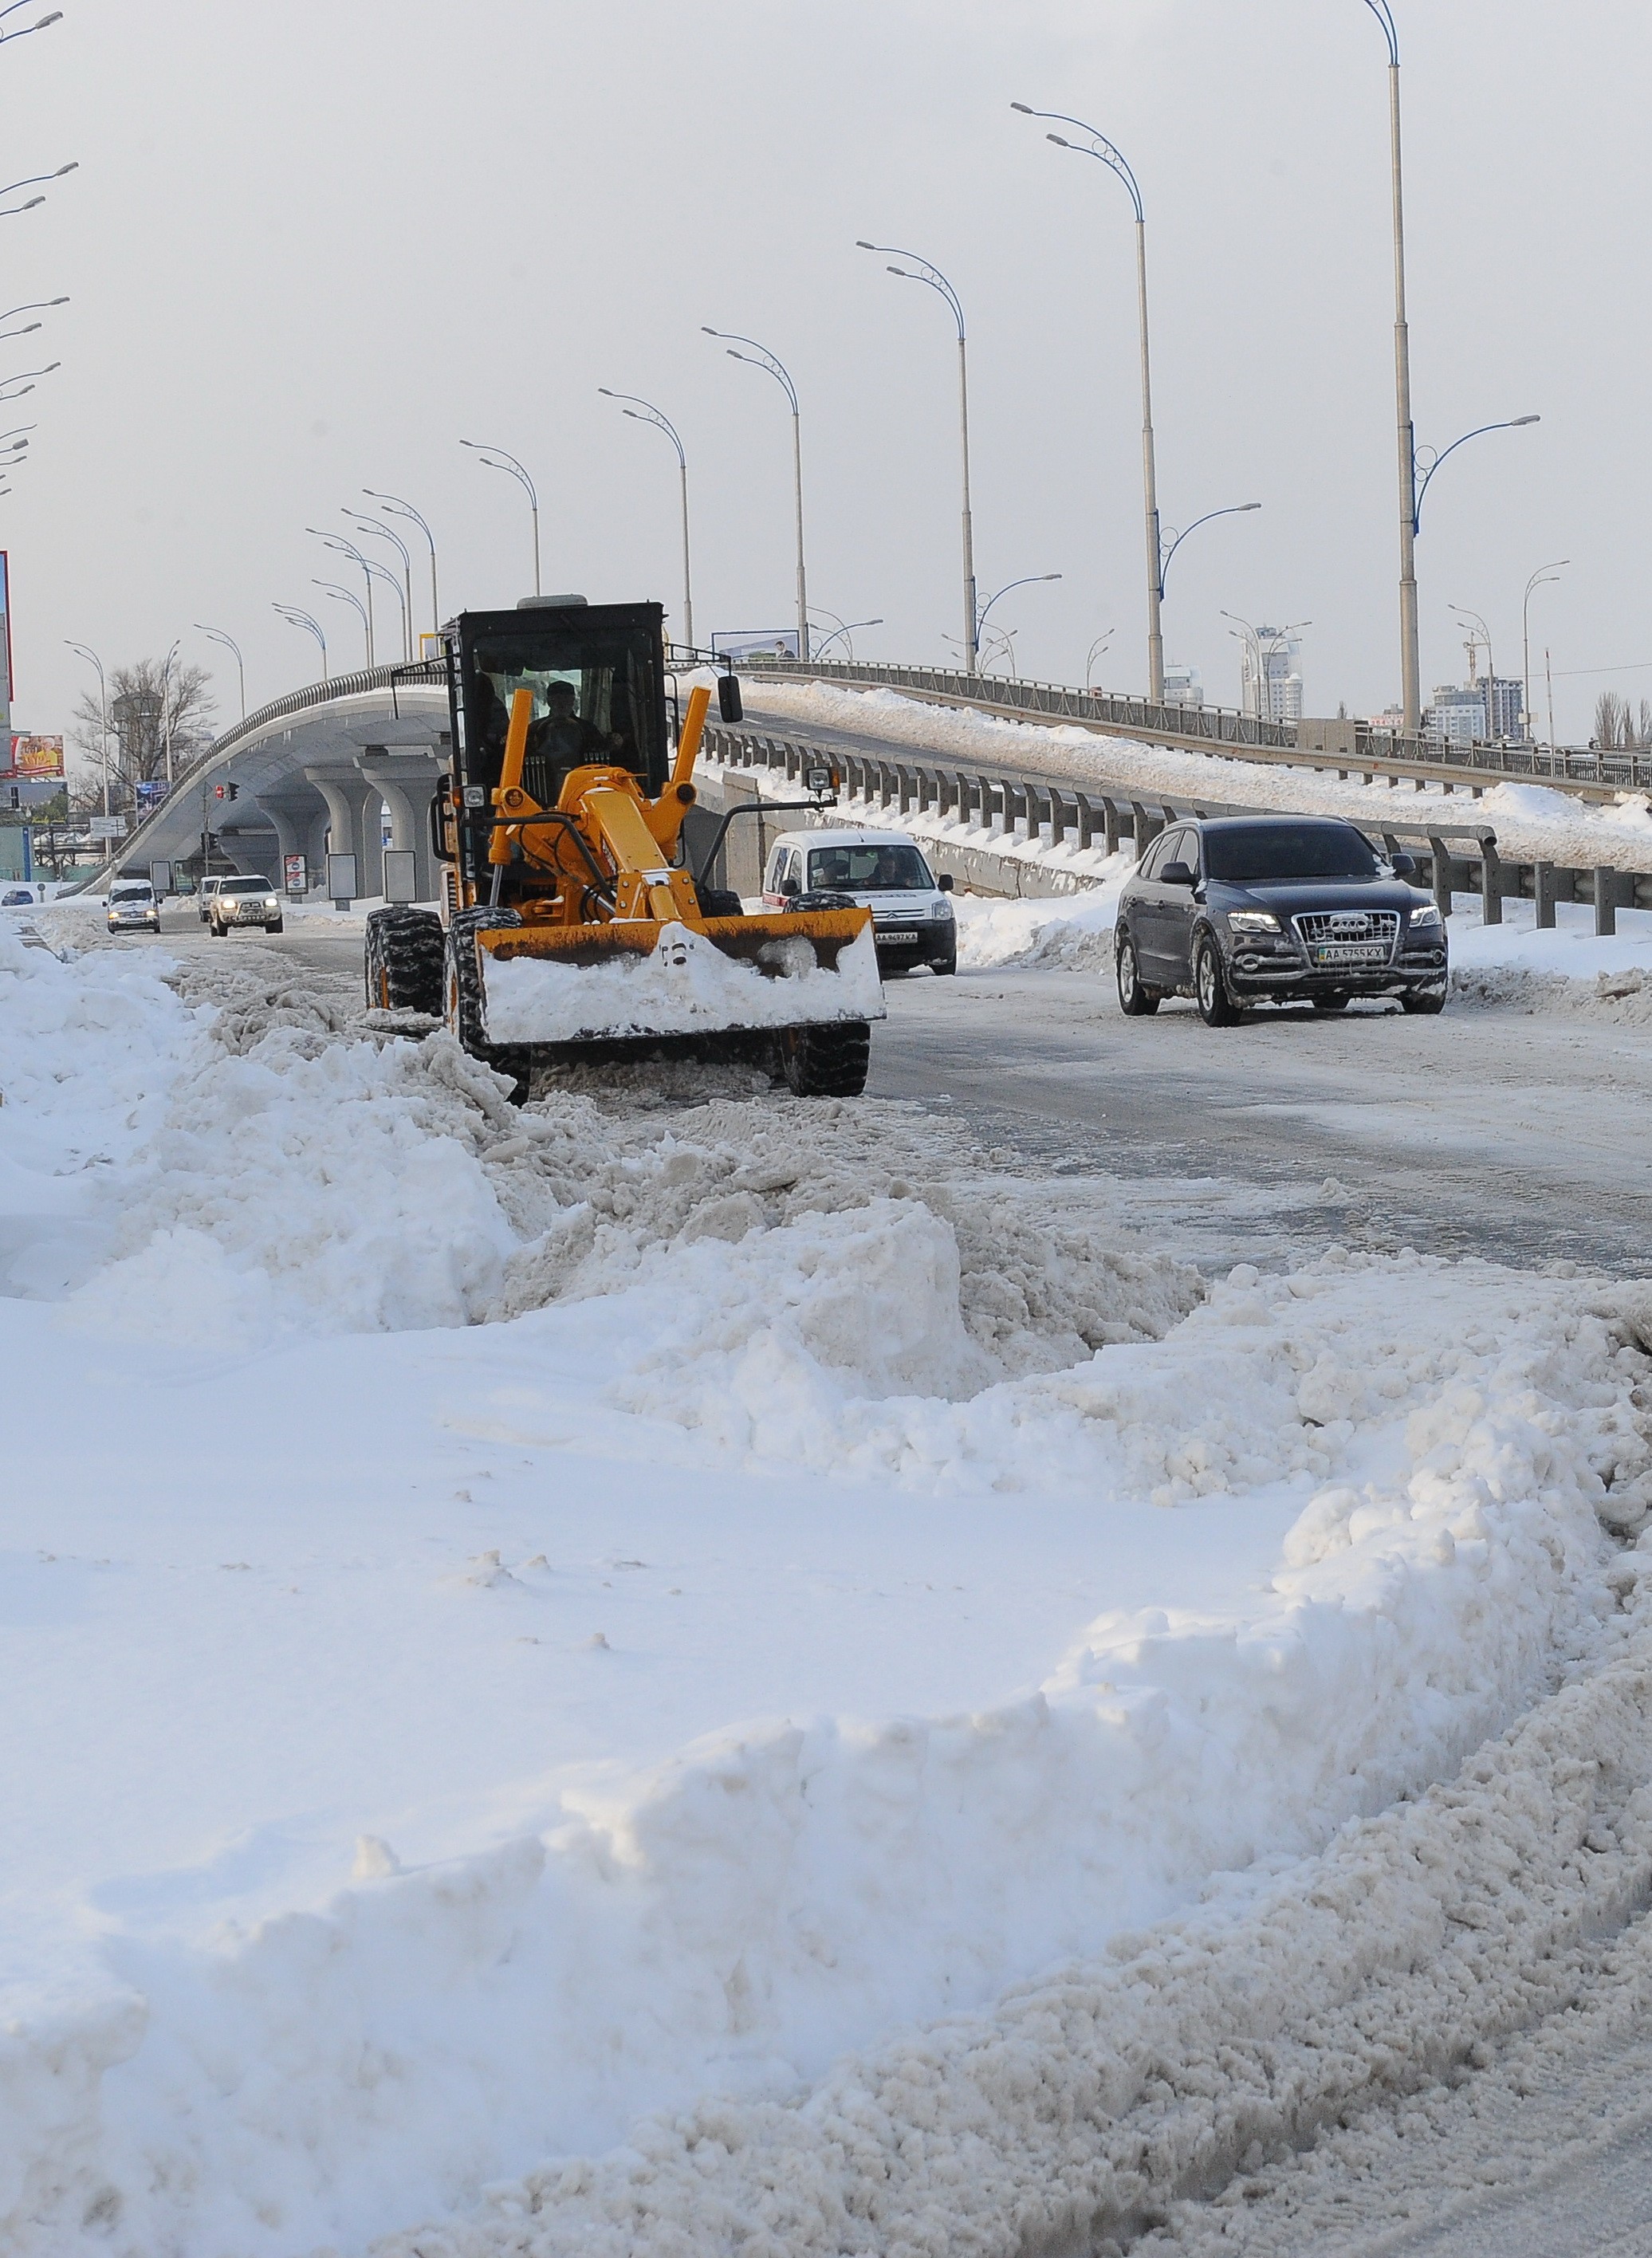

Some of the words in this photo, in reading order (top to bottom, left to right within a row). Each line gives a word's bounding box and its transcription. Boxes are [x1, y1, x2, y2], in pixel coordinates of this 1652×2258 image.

[1326, 950, 1339, 960] AA
[1342, 949, 1365, 958] 5755
[1367, 948, 1382, 958] KX
